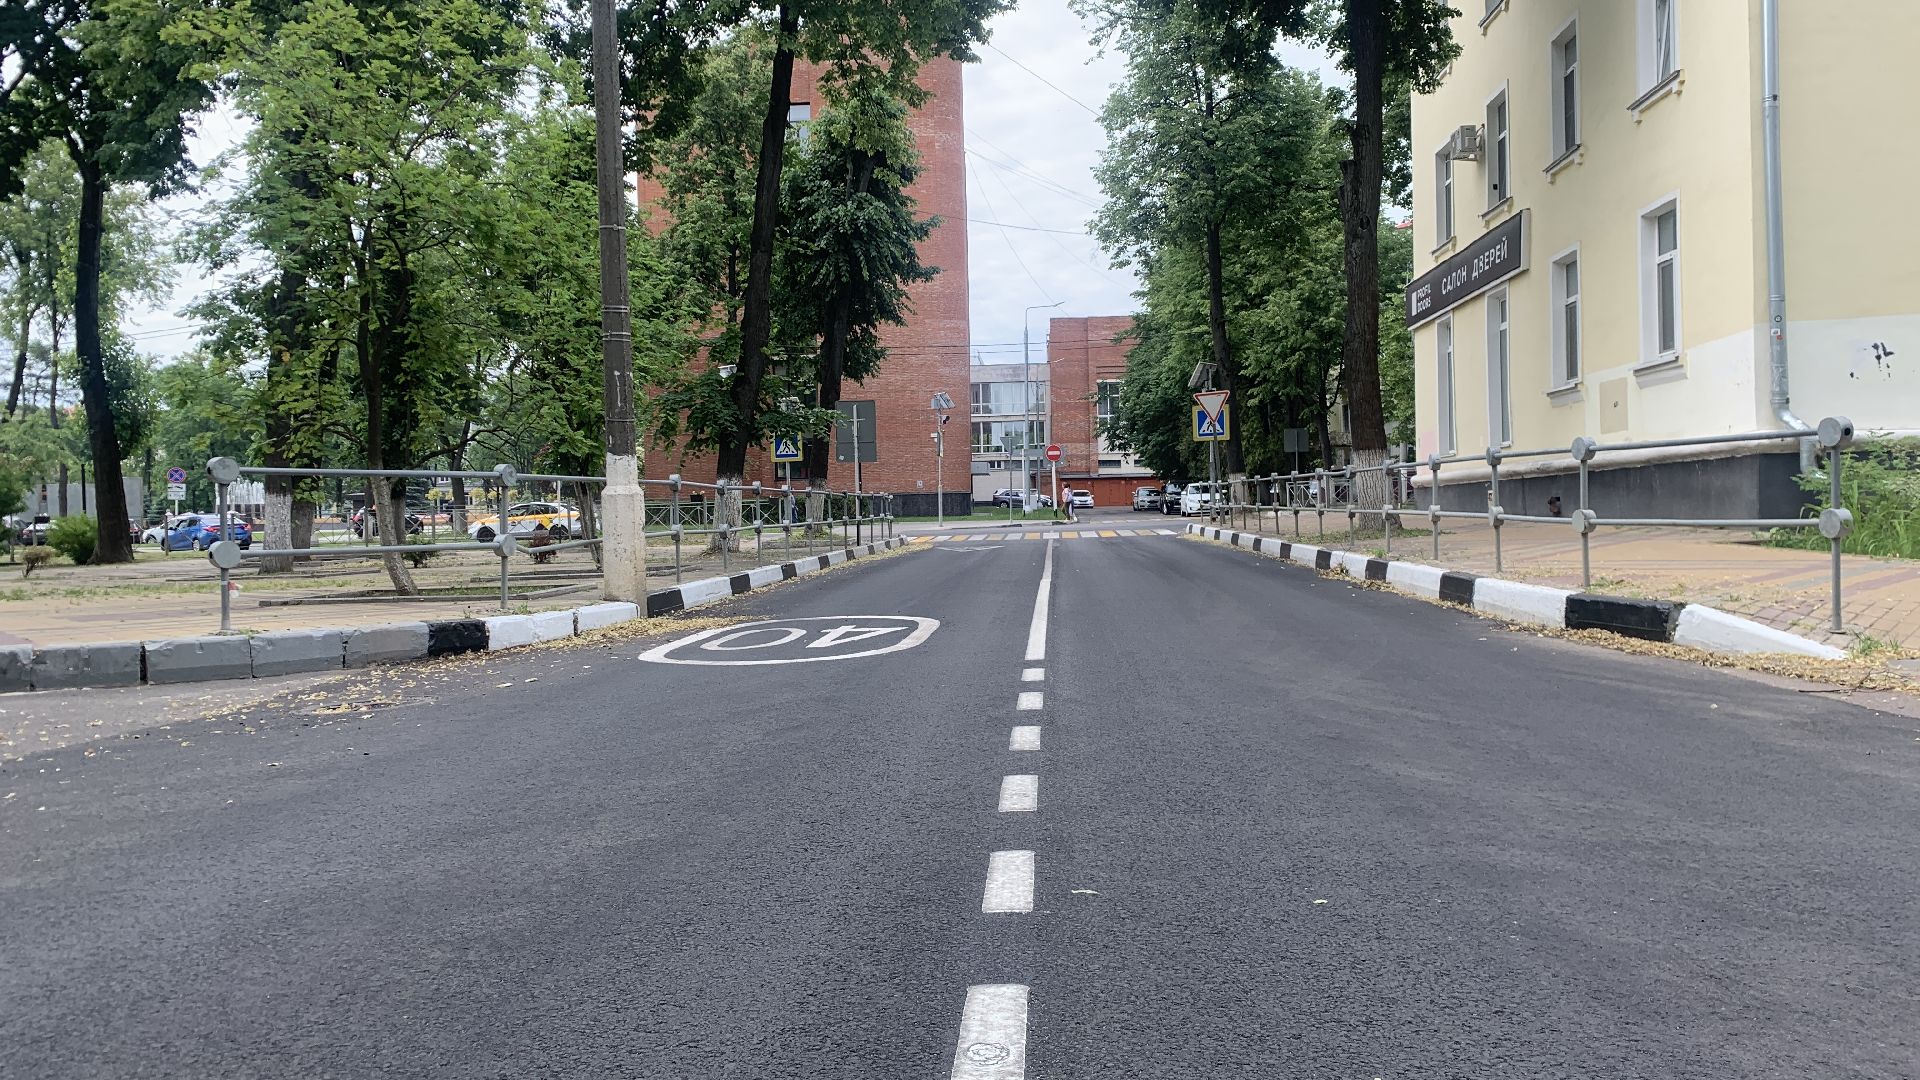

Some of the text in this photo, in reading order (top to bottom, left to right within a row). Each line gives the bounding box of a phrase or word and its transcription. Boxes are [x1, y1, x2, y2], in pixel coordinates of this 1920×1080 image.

[1441, 236, 1508, 295] САЛОН ДВЕРЕЙ
[700, 624, 909, 650] 40
